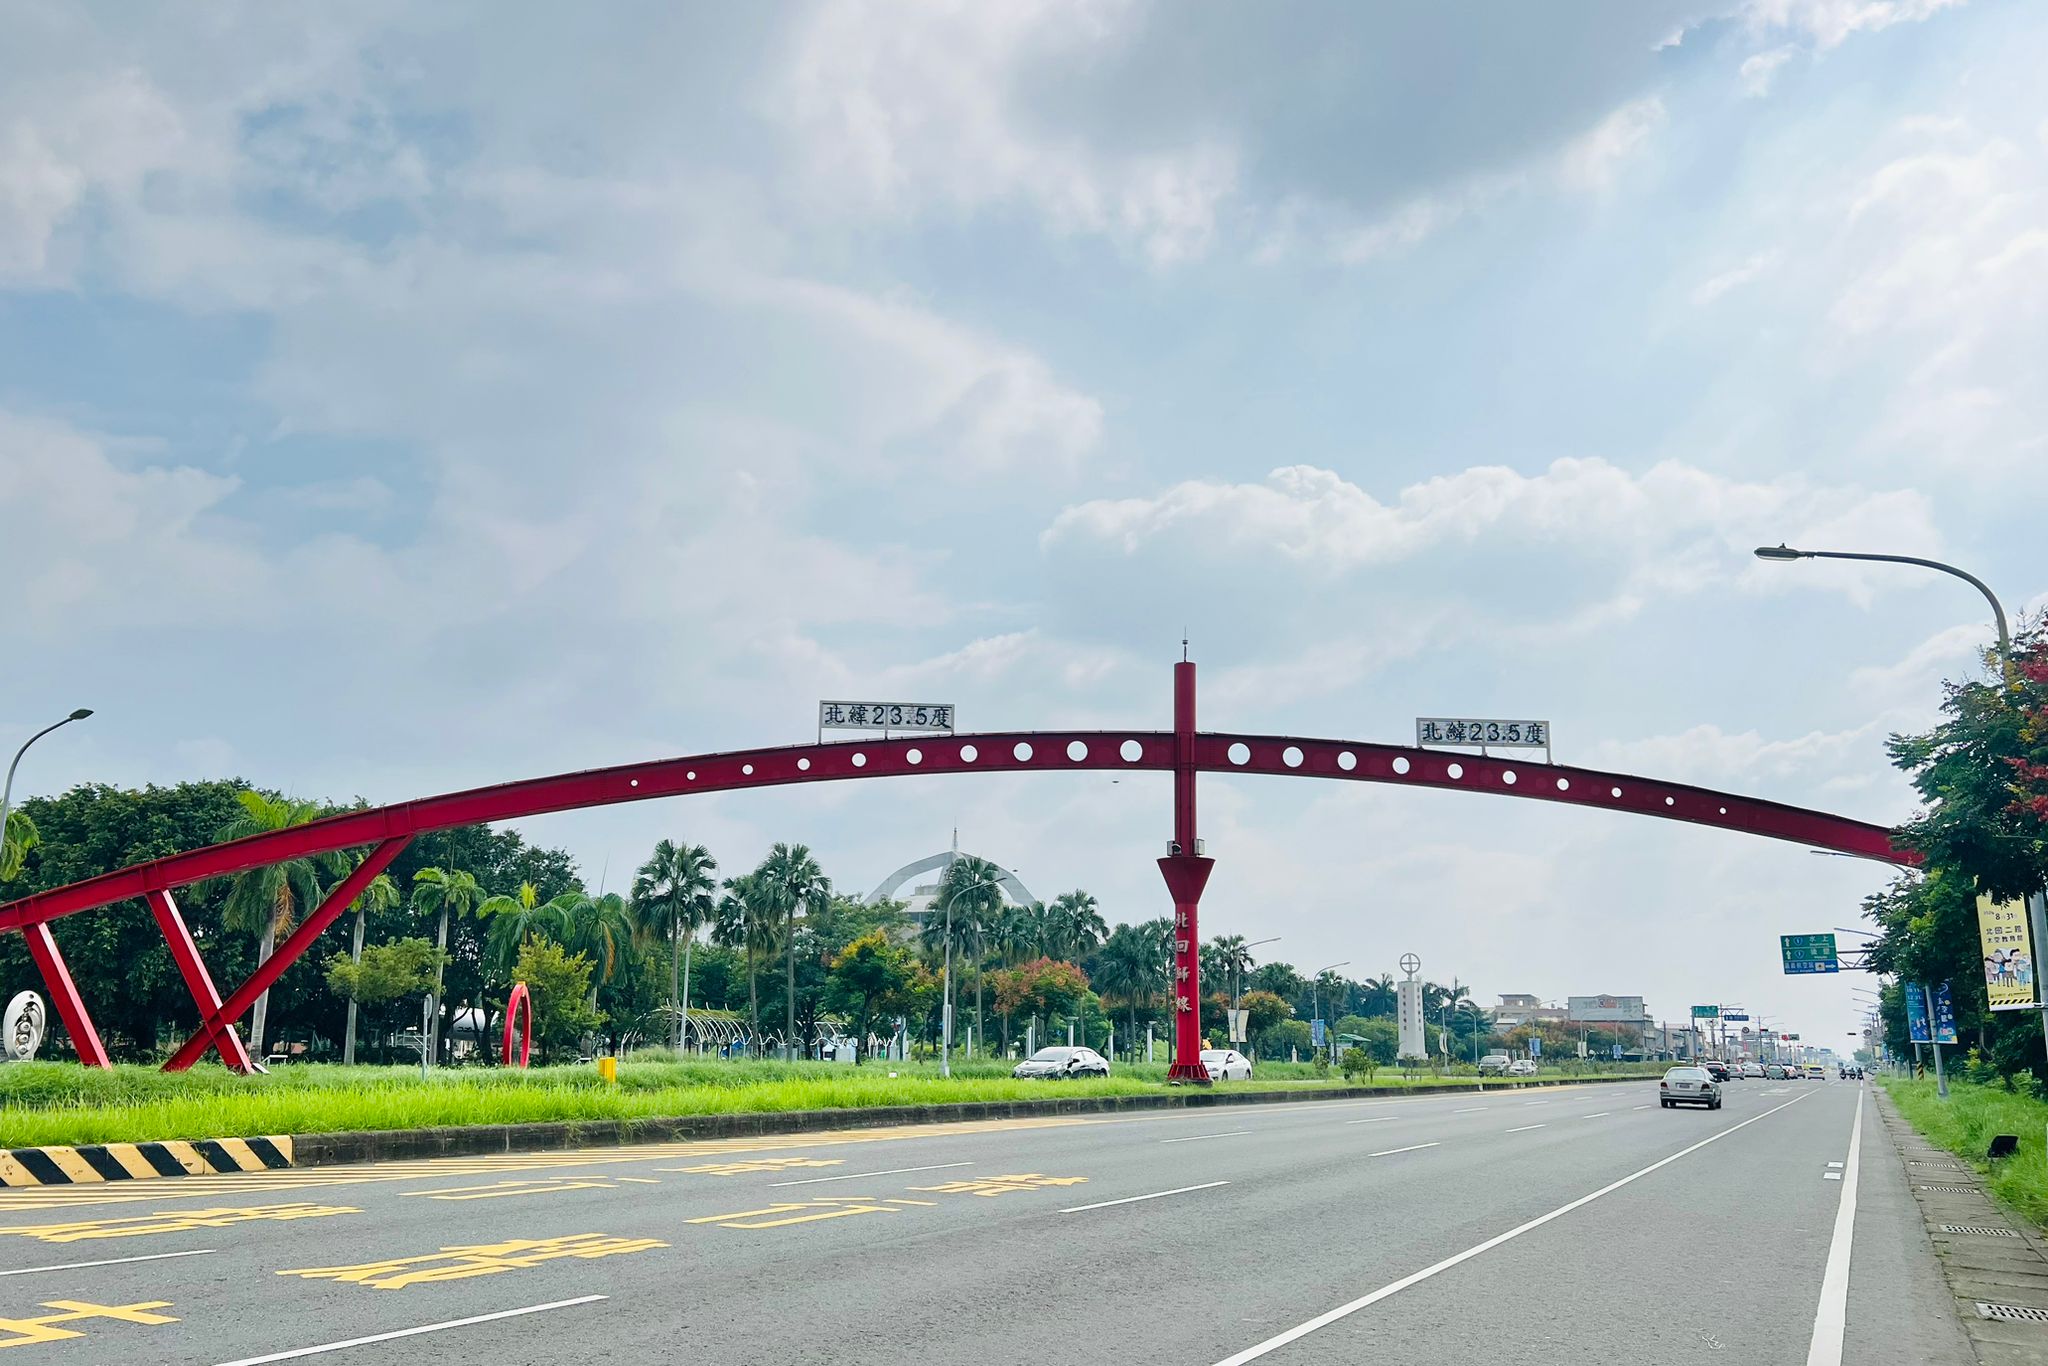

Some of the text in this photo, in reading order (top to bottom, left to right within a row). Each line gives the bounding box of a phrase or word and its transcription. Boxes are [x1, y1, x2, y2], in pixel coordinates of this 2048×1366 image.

[825, 705, 951, 728] 北緯23.5度
[1422, 721, 1545, 744] 北緯23.5度
